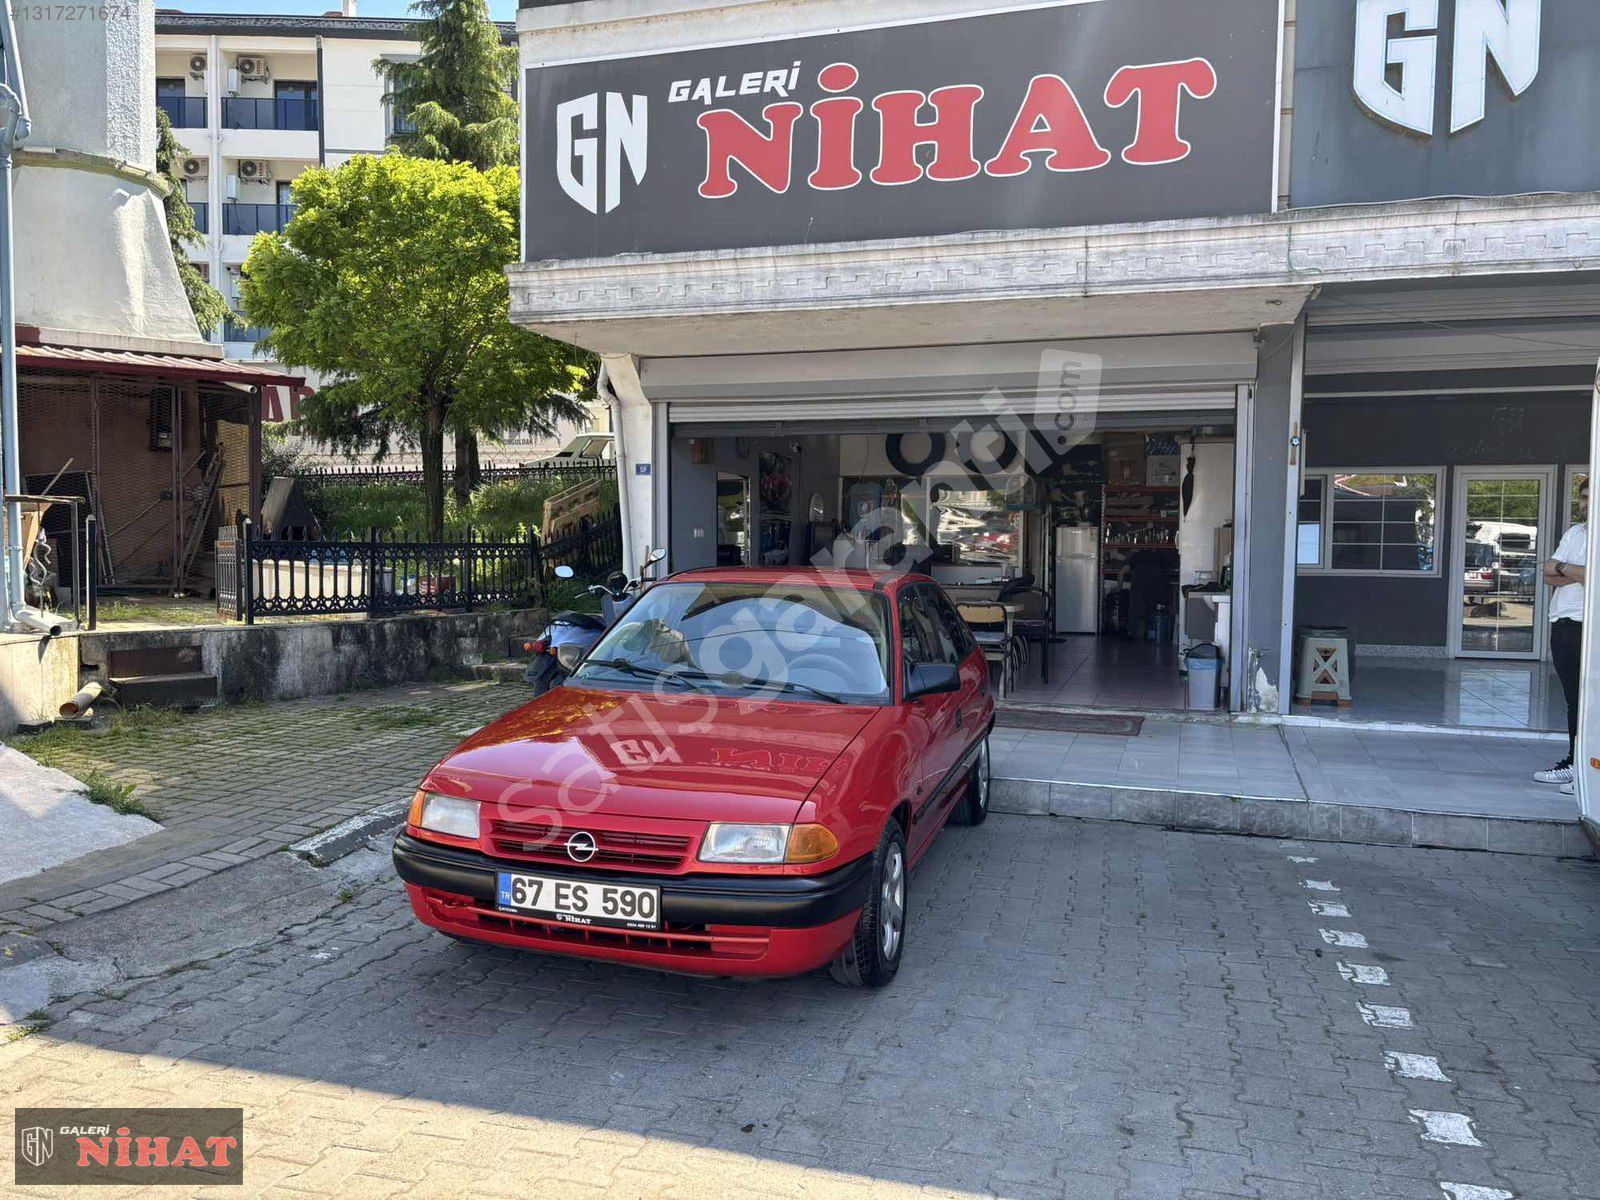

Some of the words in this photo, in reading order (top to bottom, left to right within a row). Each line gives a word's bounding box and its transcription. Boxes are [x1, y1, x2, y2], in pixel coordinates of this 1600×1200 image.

[1353, 0, 1541, 136] GN
[556, 92, 648, 214] GN
[500, 891, 511, 900] TR
[511, 877, 544, 906] 67
[554, 882, 589, 912] ES
[602, 887, 655, 919] 590
